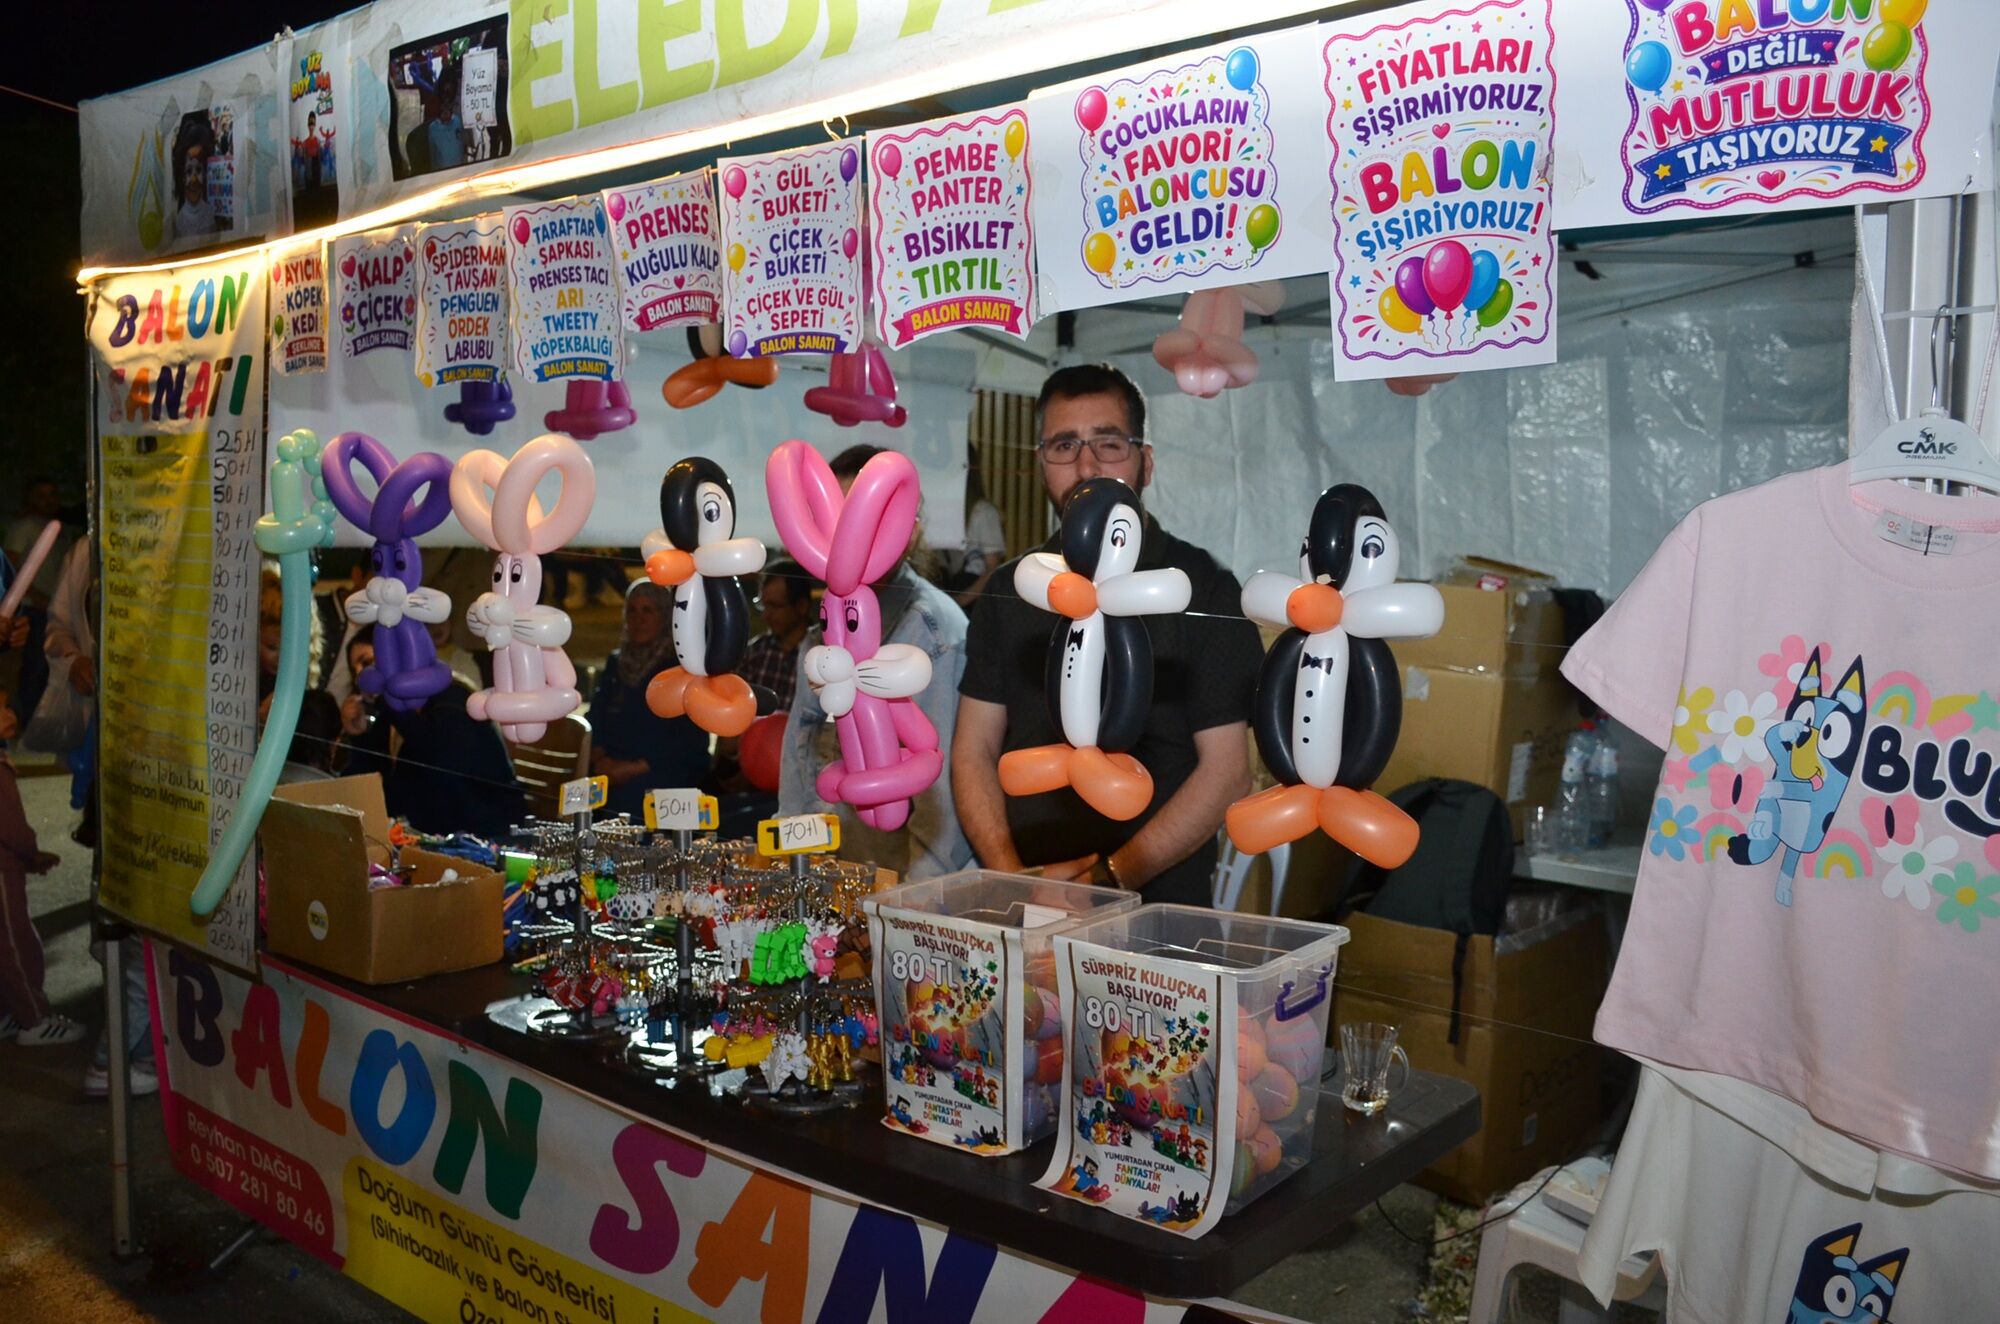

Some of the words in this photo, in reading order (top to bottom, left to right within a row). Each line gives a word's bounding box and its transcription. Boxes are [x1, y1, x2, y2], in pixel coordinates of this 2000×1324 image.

[1726, 34, 1821, 74] DEĞİL,
[1357, 38, 1533, 104] FİYATLARI
[1352, 82, 1544, 146] ŞİŞİRMİYORUZ,
[1648, 71, 1911, 149] MUTLULUK
[1100, 98, 1249, 160] ÇOCUKLARIN
[913, 142, 999, 180] PEMBE
[1123, 127, 1234, 182] FAVORİ
[1677, 125, 1865, 174] TAŞIYORUZ
[775, 163, 814, 191] GÜL
[1359, 139, 1535, 215] BALON
[762, 189, 829, 221] BUKETİ
[911, 177, 1003, 218] PANTER
[1096, 166, 1266, 228] BALONCUSU
[532, 217, 595, 245] TARAFTAR
[625, 202, 709, 250] PRENSES
[903, 219, 1015, 262] BİSİKLET
[1130, 202, 1238, 254] GELDİ!
[1355, 200, 1544, 263] ŞİŞİRİYORUZ!
[539, 241, 594, 268] ŞAPKASI
[769, 228, 824, 258] ÇİÇEK
[357, 256, 404, 291] KALP
[444, 269, 498, 293] TAVŞAN
[529, 265, 582, 292] PRENSES
[625, 243, 687, 287] KUĞULU
[691, 243, 720, 272] KALP
[765, 251, 827, 280] BUKETİ
[912, 257, 1004, 299] TIRTIL
[109, 272, 249, 348] BALON
[286, 286, 322, 313] KÖPEK
[357, 294, 404, 331] ÇİÇEK
[440, 292, 500, 318] PENGUEN
[556, 288, 584, 309] ARI
[648, 300, 681, 323] BALON
[682, 296, 713, 315] SANATI
[747, 289, 792, 316] ÇİÇEK
[796, 287, 814, 305] VE
[818, 284, 845, 310] GÜL
[292, 311, 319, 337] KEDİ
[448, 312, 491, 340] ÖRDEK
[543, 312, 598, 334] TWEETY
[770, 309, 825, 331] SEPETİ
[911, 306, 961, 331] BALON
[963, 301, 1012, 326] SANATI
[356, 333, 379, 350] BALON
[445, 339, 494, 363] LABUBU
[530, 332, 613, 361] KÖPEKBALIĞI
[759, 334, 797, 355] BALON
[798, 332, 836, 352] SANATI
[543, 361, 574, 377] BALON
[576, 360, 607, 374] SANATI
[108, 355, 253, 424] SANATI
[1897, 441, 1956, 455] CMK
[1861, 723, 2000, 840] BLU
[913, 934, 969, 962] BAŞLIYOR!
[937, 923, 995, 954] KULUÇKA
[891, 950, 926, 984] 80
[930, 956, 960, 990] TL
[1081, 960, 1136, 983] SÜRPRİZ
[1140, 968, 1207, 1004] KULUÇKA
[1106, 980, 1177, 1012] BAŞLIYOR!
[1084, 996, 1121, 1033] 80
[1126, 1005, 1162, 1044] TL
[914, 1090, 953, 1107] YUMURTADAN
[923, 1110, 963, 1128] DÜNYALAR!
[168, 948, 543, 1220] BALON
[588, 1121, 1255, 1324] SAN
[187, 1111, 246, 1161] Reyhan
[250, 1144, 302, 1192] DAĞLI
[1104, 1150, 1152, 1169] YUMURTADAN
[1153, 1160, 1175, 1175] ÇIKAN
[1116, 1162, 1162, 1181] FANTASTİK
[191, 1143, 201, 1164] 0
[205, 1151, 234, 1182] 507
[240, 1171, 268, 1204] 281
[276, 1190, 298, 1220] 80
[303, 1207, 326, 1237] 46
[1114, 1173, 1160, 1194] DÜNYALAR!
[358, 1165, 437, 1230] Doğum
[440, 1211, 502, 1266] Günü
[508, 1247, 617, 1323] Gösterisi
[371, 1213, 461, 1280] (Sihirbazlık
[464, 1267, 488, 1293] ve
[493, 1278, 549, 1324] Balon
